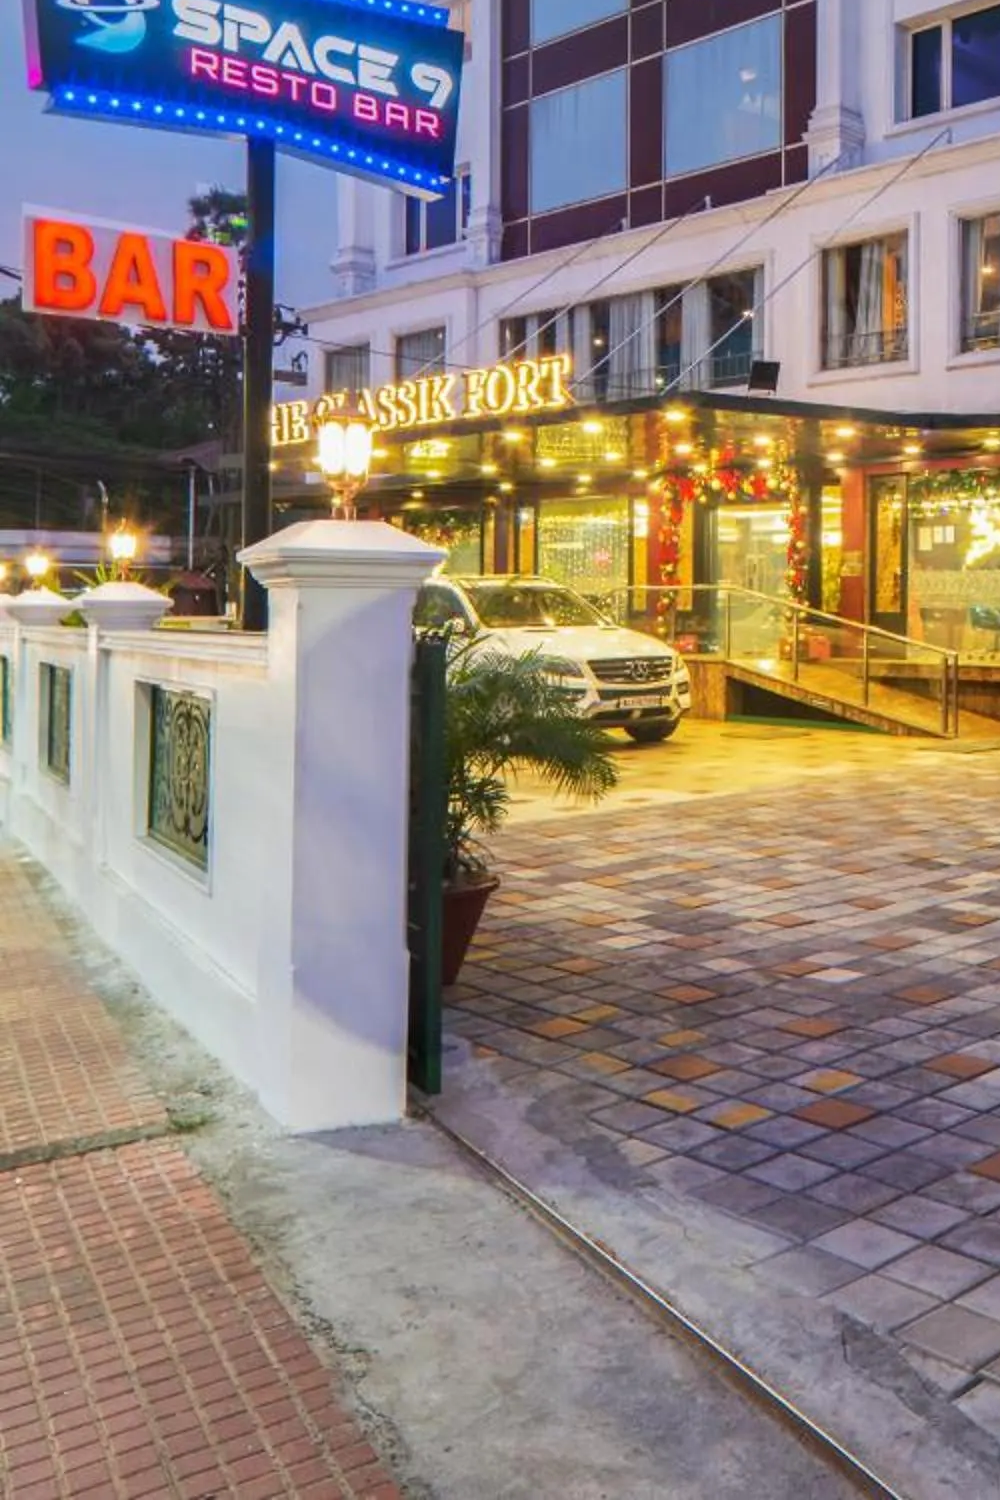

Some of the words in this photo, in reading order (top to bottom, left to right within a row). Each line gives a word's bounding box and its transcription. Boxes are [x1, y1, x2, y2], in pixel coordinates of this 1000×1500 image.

[190, 47, 338, 111] RESTO
[353, 96, 442, 138] BAR
[411, 63, 454, 110] 9
[33, 217, 233, 330] BAR
[271, 400, 309, 446] HE
[462, 353, 575, 418] FORT
